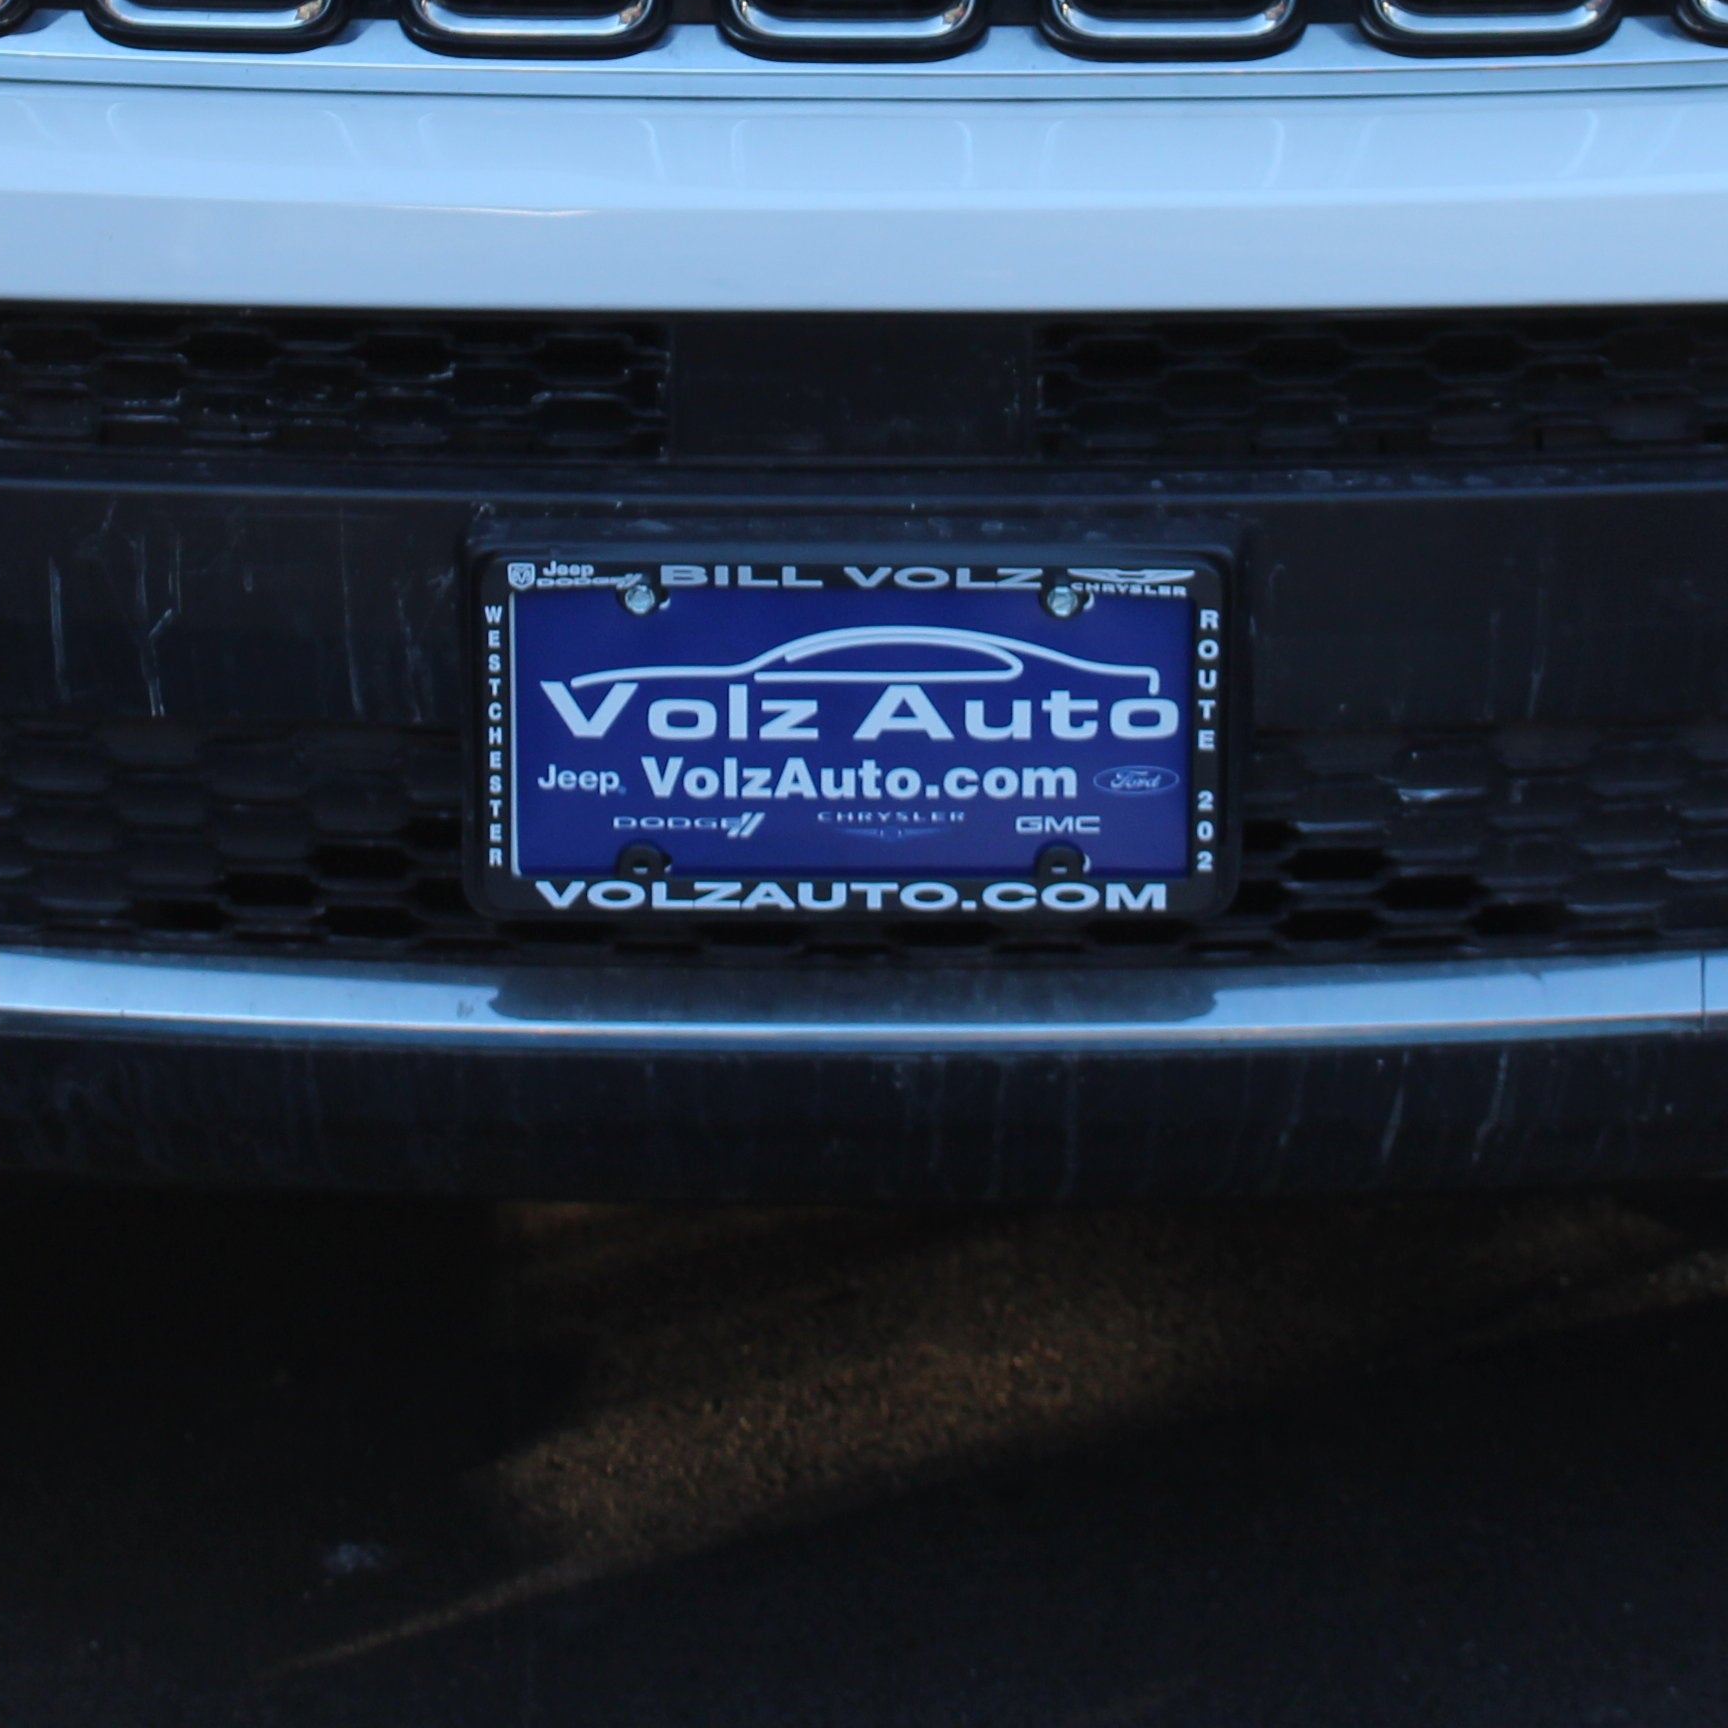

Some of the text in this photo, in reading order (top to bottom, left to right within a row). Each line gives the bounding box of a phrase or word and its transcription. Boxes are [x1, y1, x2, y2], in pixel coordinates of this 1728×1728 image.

[542, 560, 594, 579] Jeep
[660, 565, 1042, 589] BILL VOLZ
[1071, 581, 1187, 597] CHRYSLER
[540, 680, 1180, 740] Volz Auto
[483, 605, 503, 867] WESTCHESTER
[1196, 608, 1220, 872] ROUTE 202
[537, 763, 620, 797] Jeep
[640, 755, 1078, 799] VolzAuto.com
[1110, 770, 1162, 789] Ford
[817, 810, 965, 823] CHRYSLER
[1015, 815, 1102, 834] GMC
[534, 879, 1168, 912] VOLZAUTO.COM
